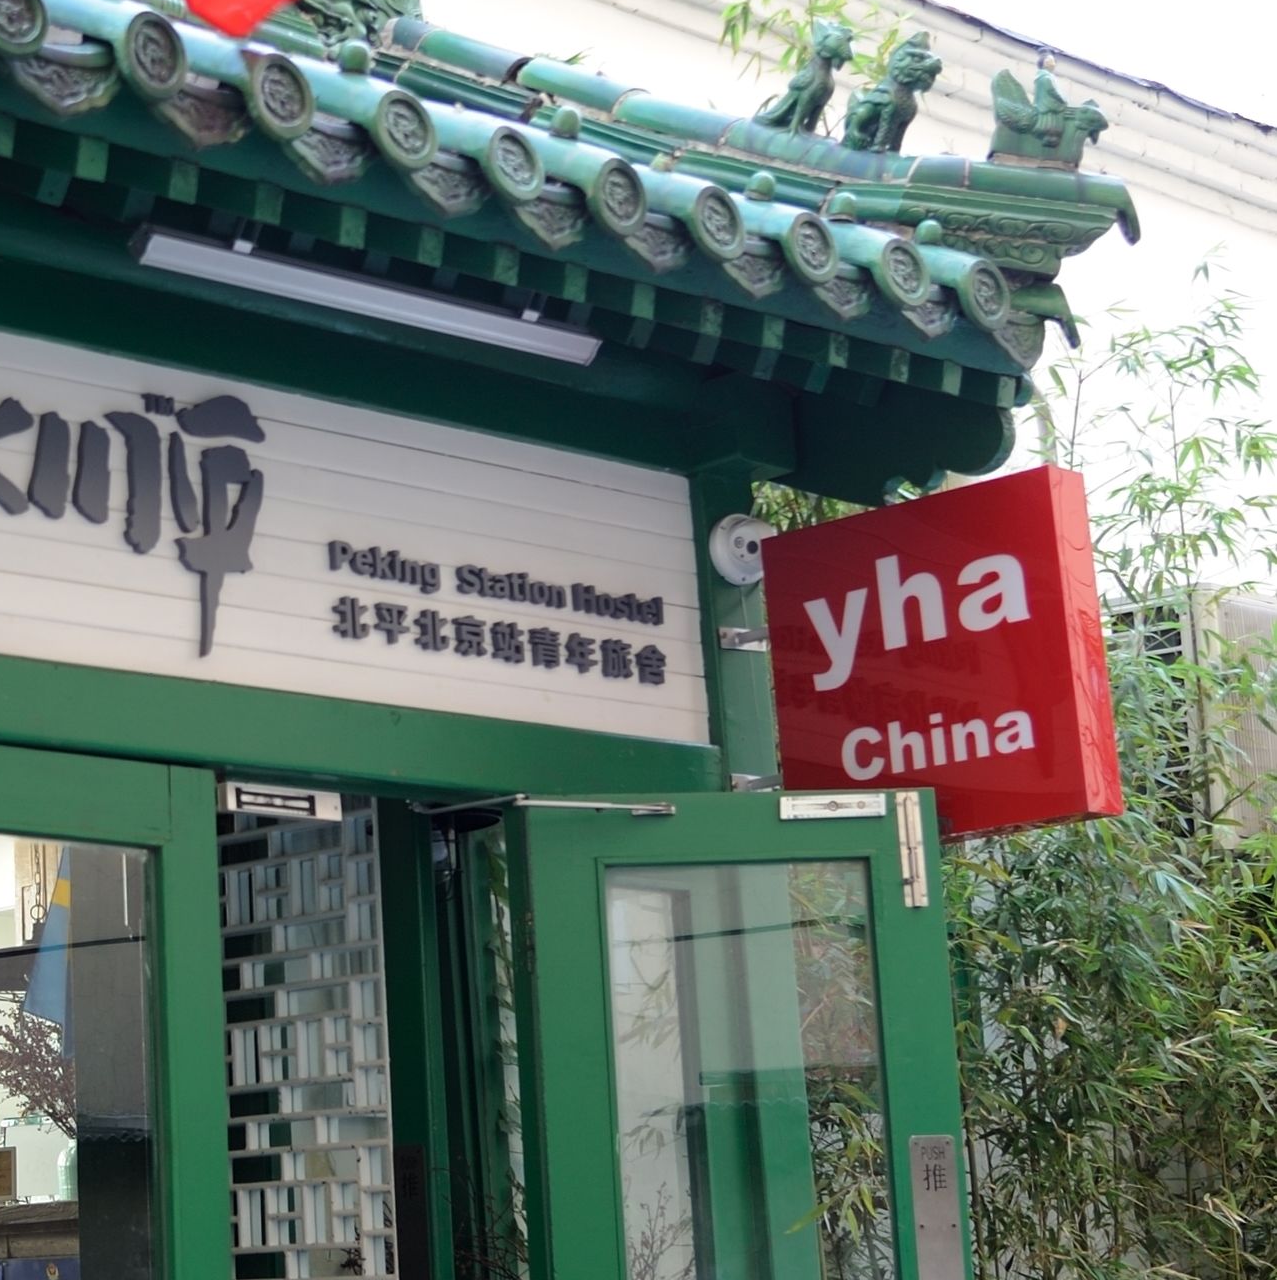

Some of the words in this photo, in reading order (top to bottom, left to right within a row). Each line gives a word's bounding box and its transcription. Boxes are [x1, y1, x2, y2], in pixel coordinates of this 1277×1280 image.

[328, 539, 441, 594] Peking
[455, 564, 566, 609] Station
[571, 582, 664, 626] Hostel
[332, 596, 666, 686] 北平北京站青年旅舍
[803, 553, 1031, 692] yha
[841, 710, 1036, 781] China
[920, 1145, 945, 1160] PUSH
[923, 1163, 947, 1192] 推
